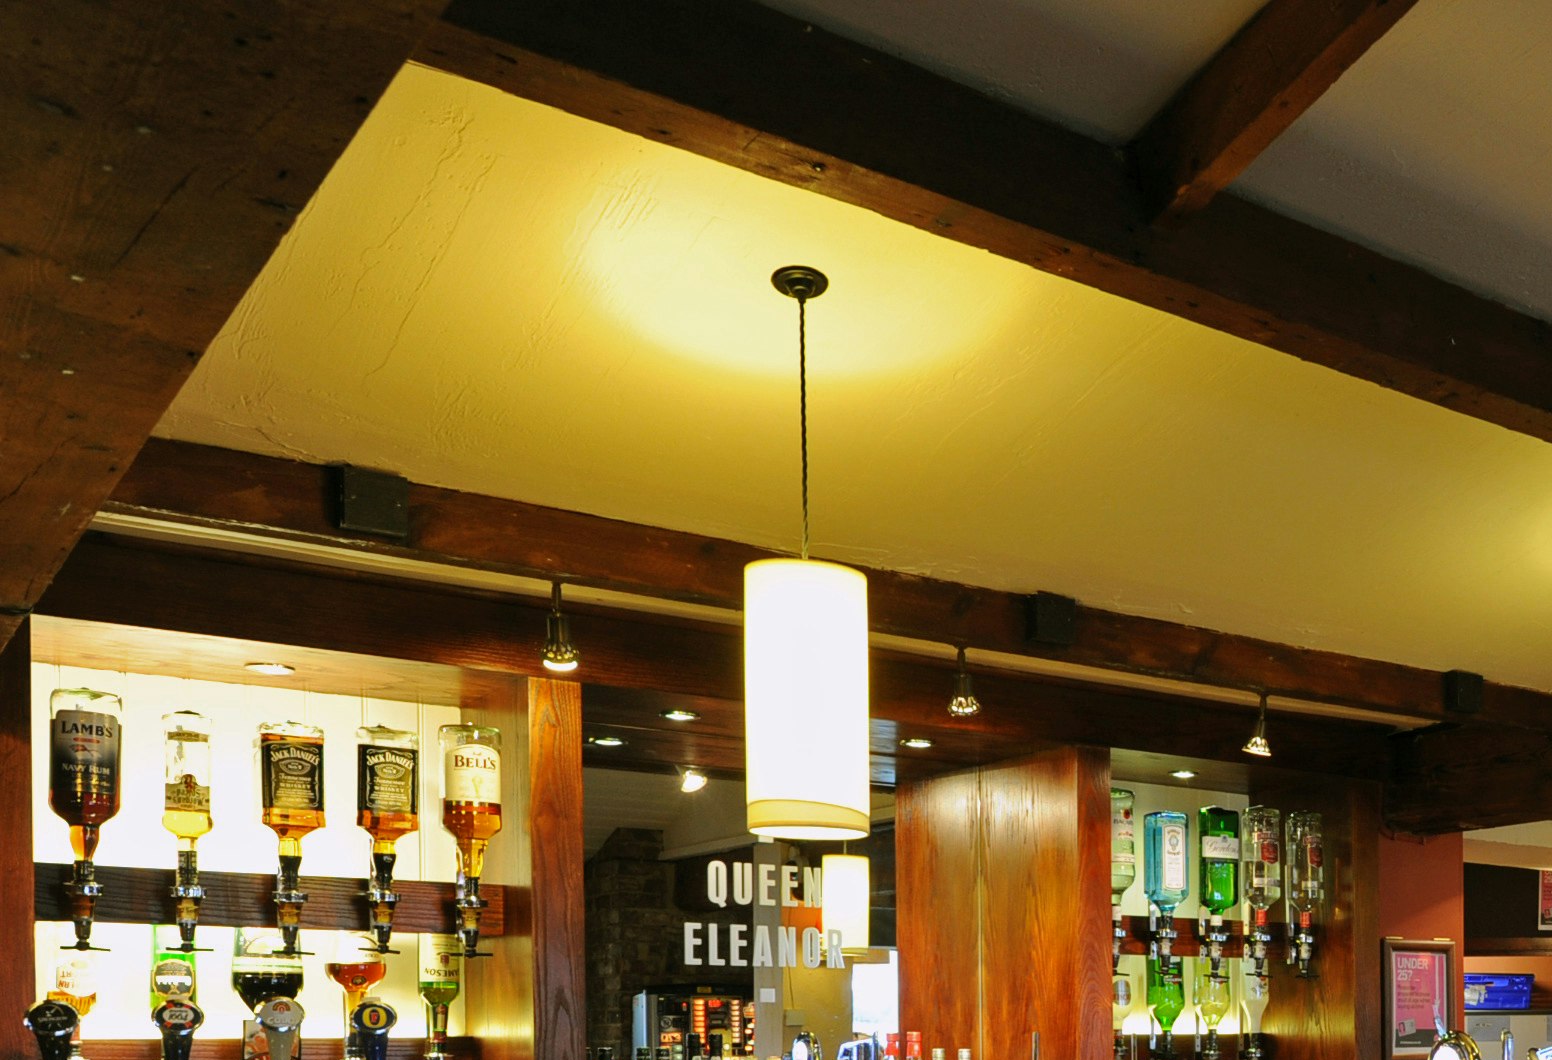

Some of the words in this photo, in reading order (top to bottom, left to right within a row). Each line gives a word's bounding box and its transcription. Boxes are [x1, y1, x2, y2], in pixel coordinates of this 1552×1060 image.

[61, 720, 113, 738] LAMB'S
[271, 750, 289, 762] JACK
[366, 754, 385, 766] JACK
[454, 754, 497, 770] BELL'S
[62, 762, 85, 772] NAVY
[89, 764, 110, 775] RUM
[707, 860, 822, 908] QUEEN
[683, 921, 846, 969] ELEANOR
[1397, 957, 1429, 970] UNDER
[1397, 970, 1413, 981] 25?
